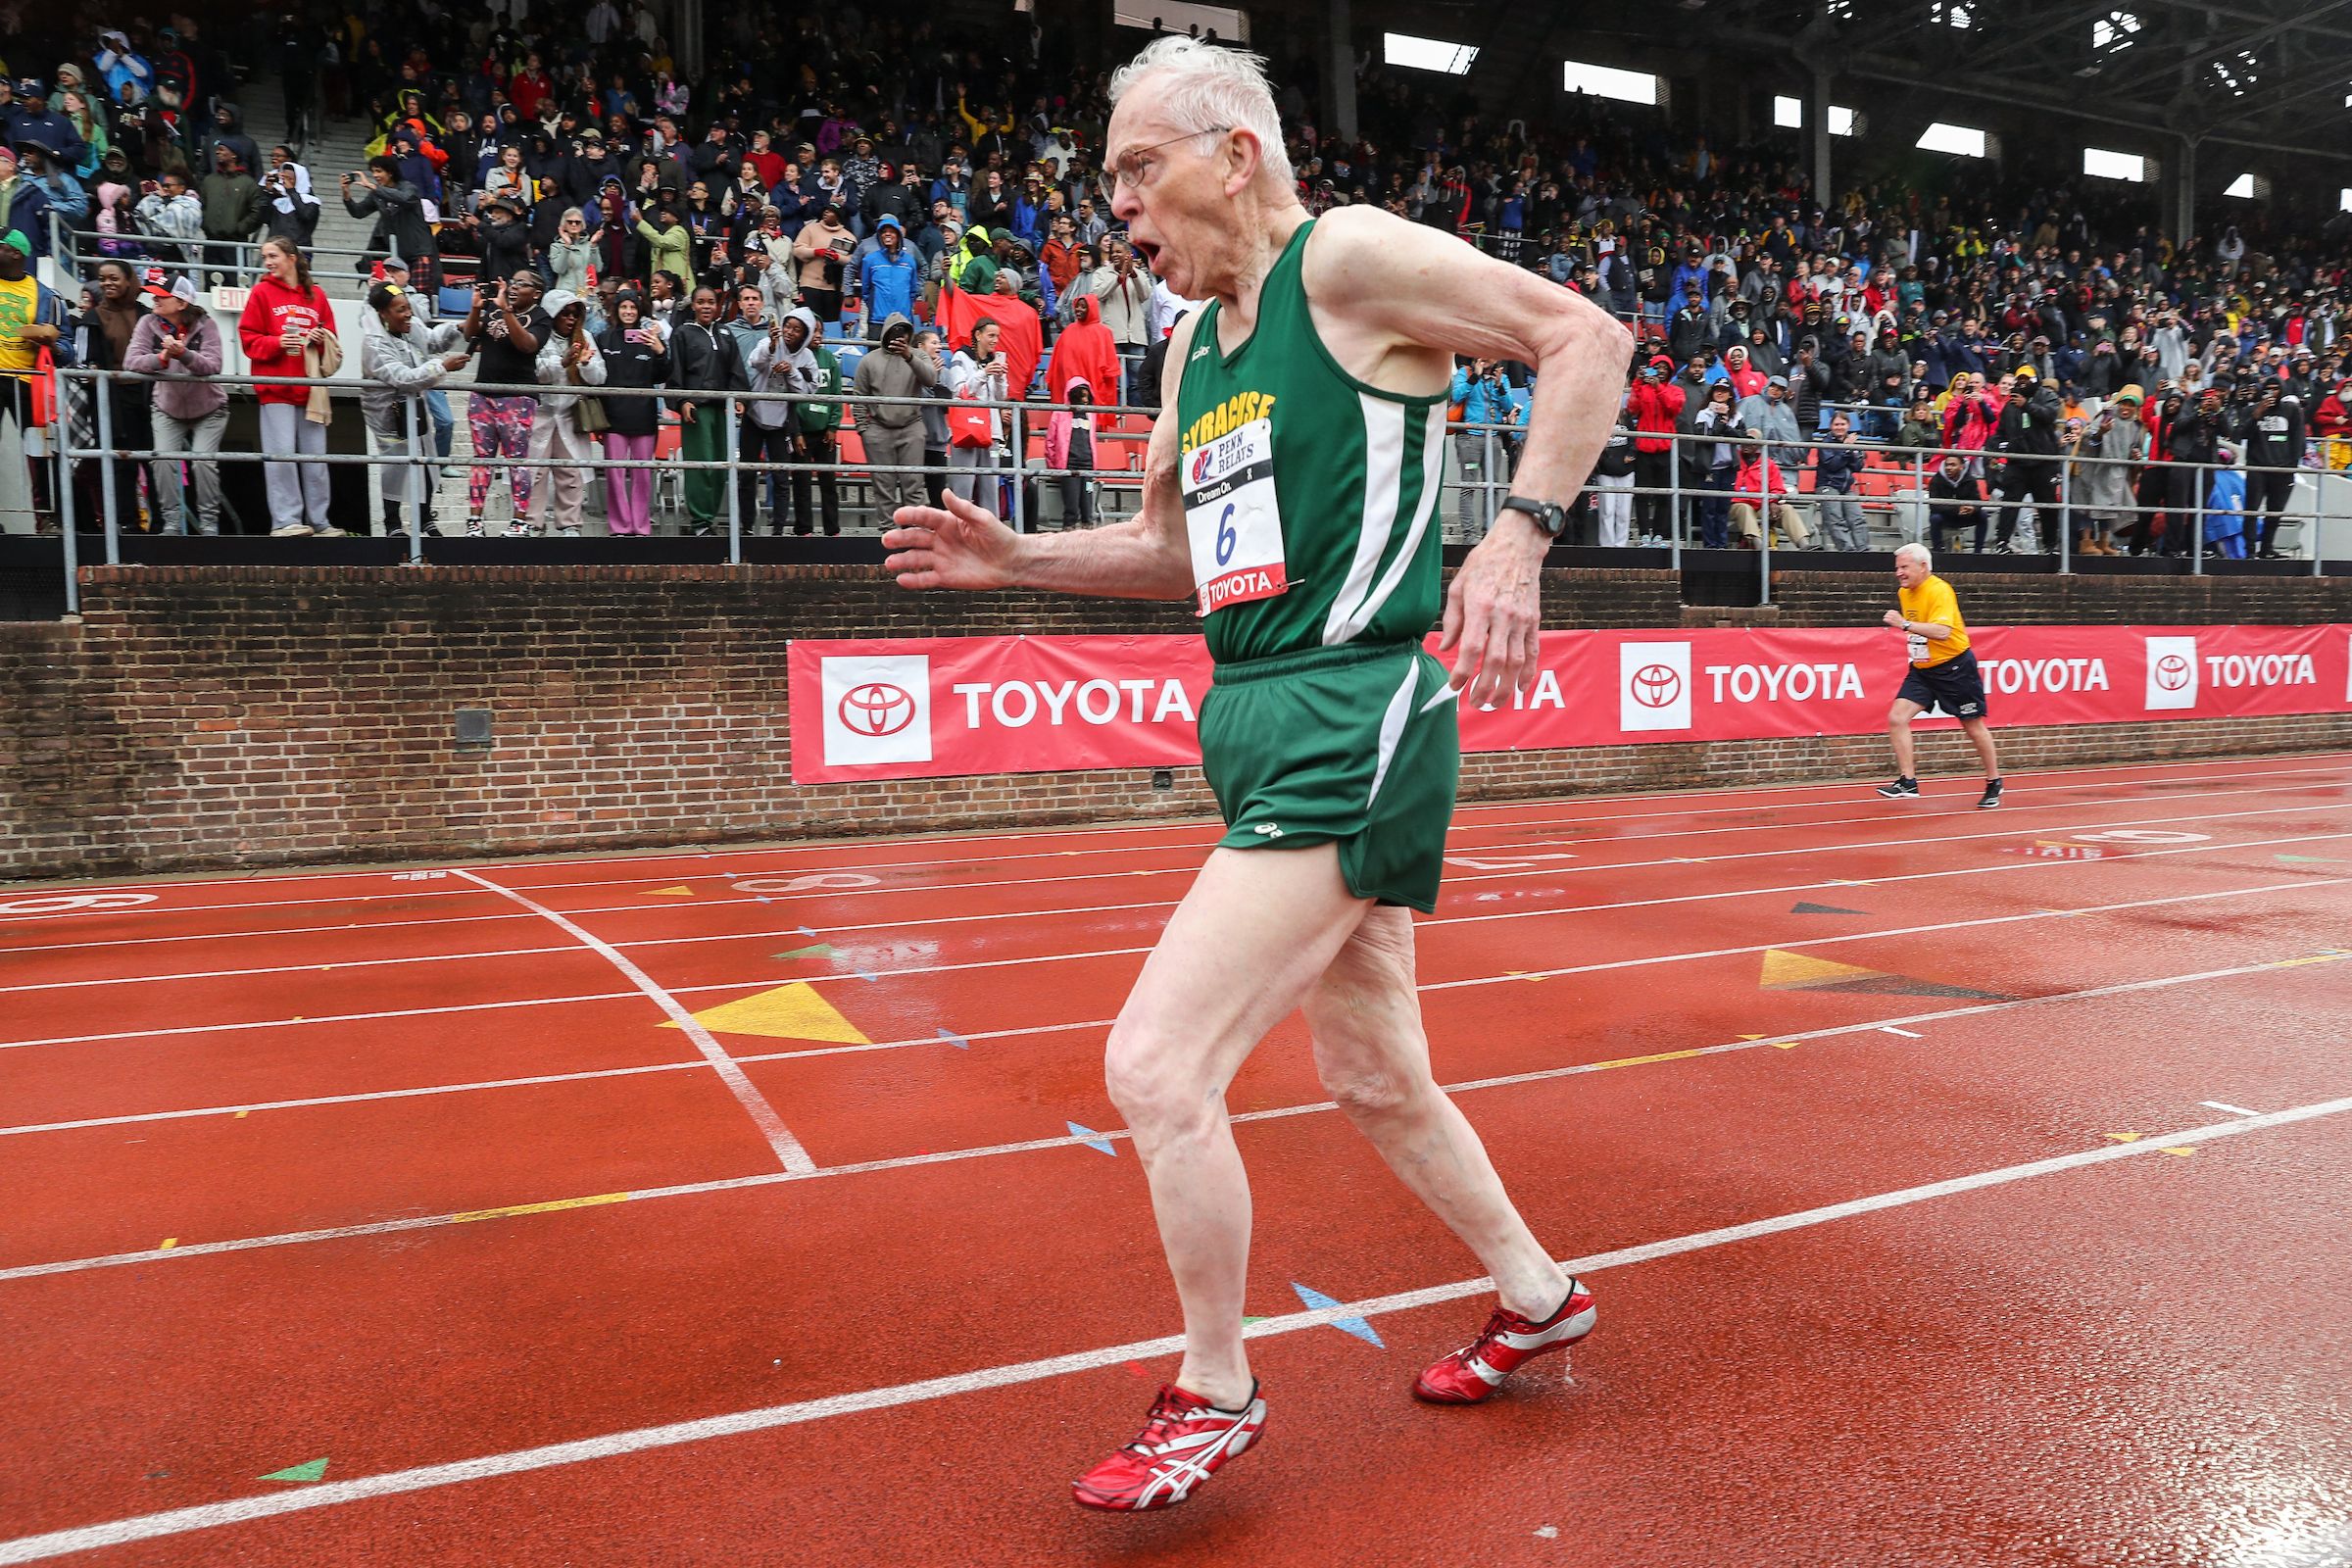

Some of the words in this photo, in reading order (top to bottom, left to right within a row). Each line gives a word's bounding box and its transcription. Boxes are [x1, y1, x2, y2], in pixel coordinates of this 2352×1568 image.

[219, 289, 247, 308] EXIT
[1182, 391, 1276, 455] SYRACUSE
[1218, 431, 1244, 457] PENN
[1218, 443, 1254, 473] RELAYS
[1197, 486, 1221, 504] Dream
[1215, 503, 1236, 566] 6
[1209, 571, 1273, 604] TOYOTA
[1705, 662, 1865, 704] TOYOTA
[1977, 658, 2109, 694] TOYOTA
[2205, 655, 2317, 688] TOYOTA
[953, 678, 1197, 728] TOYOTA
[730, 873, 882, 893] 8
